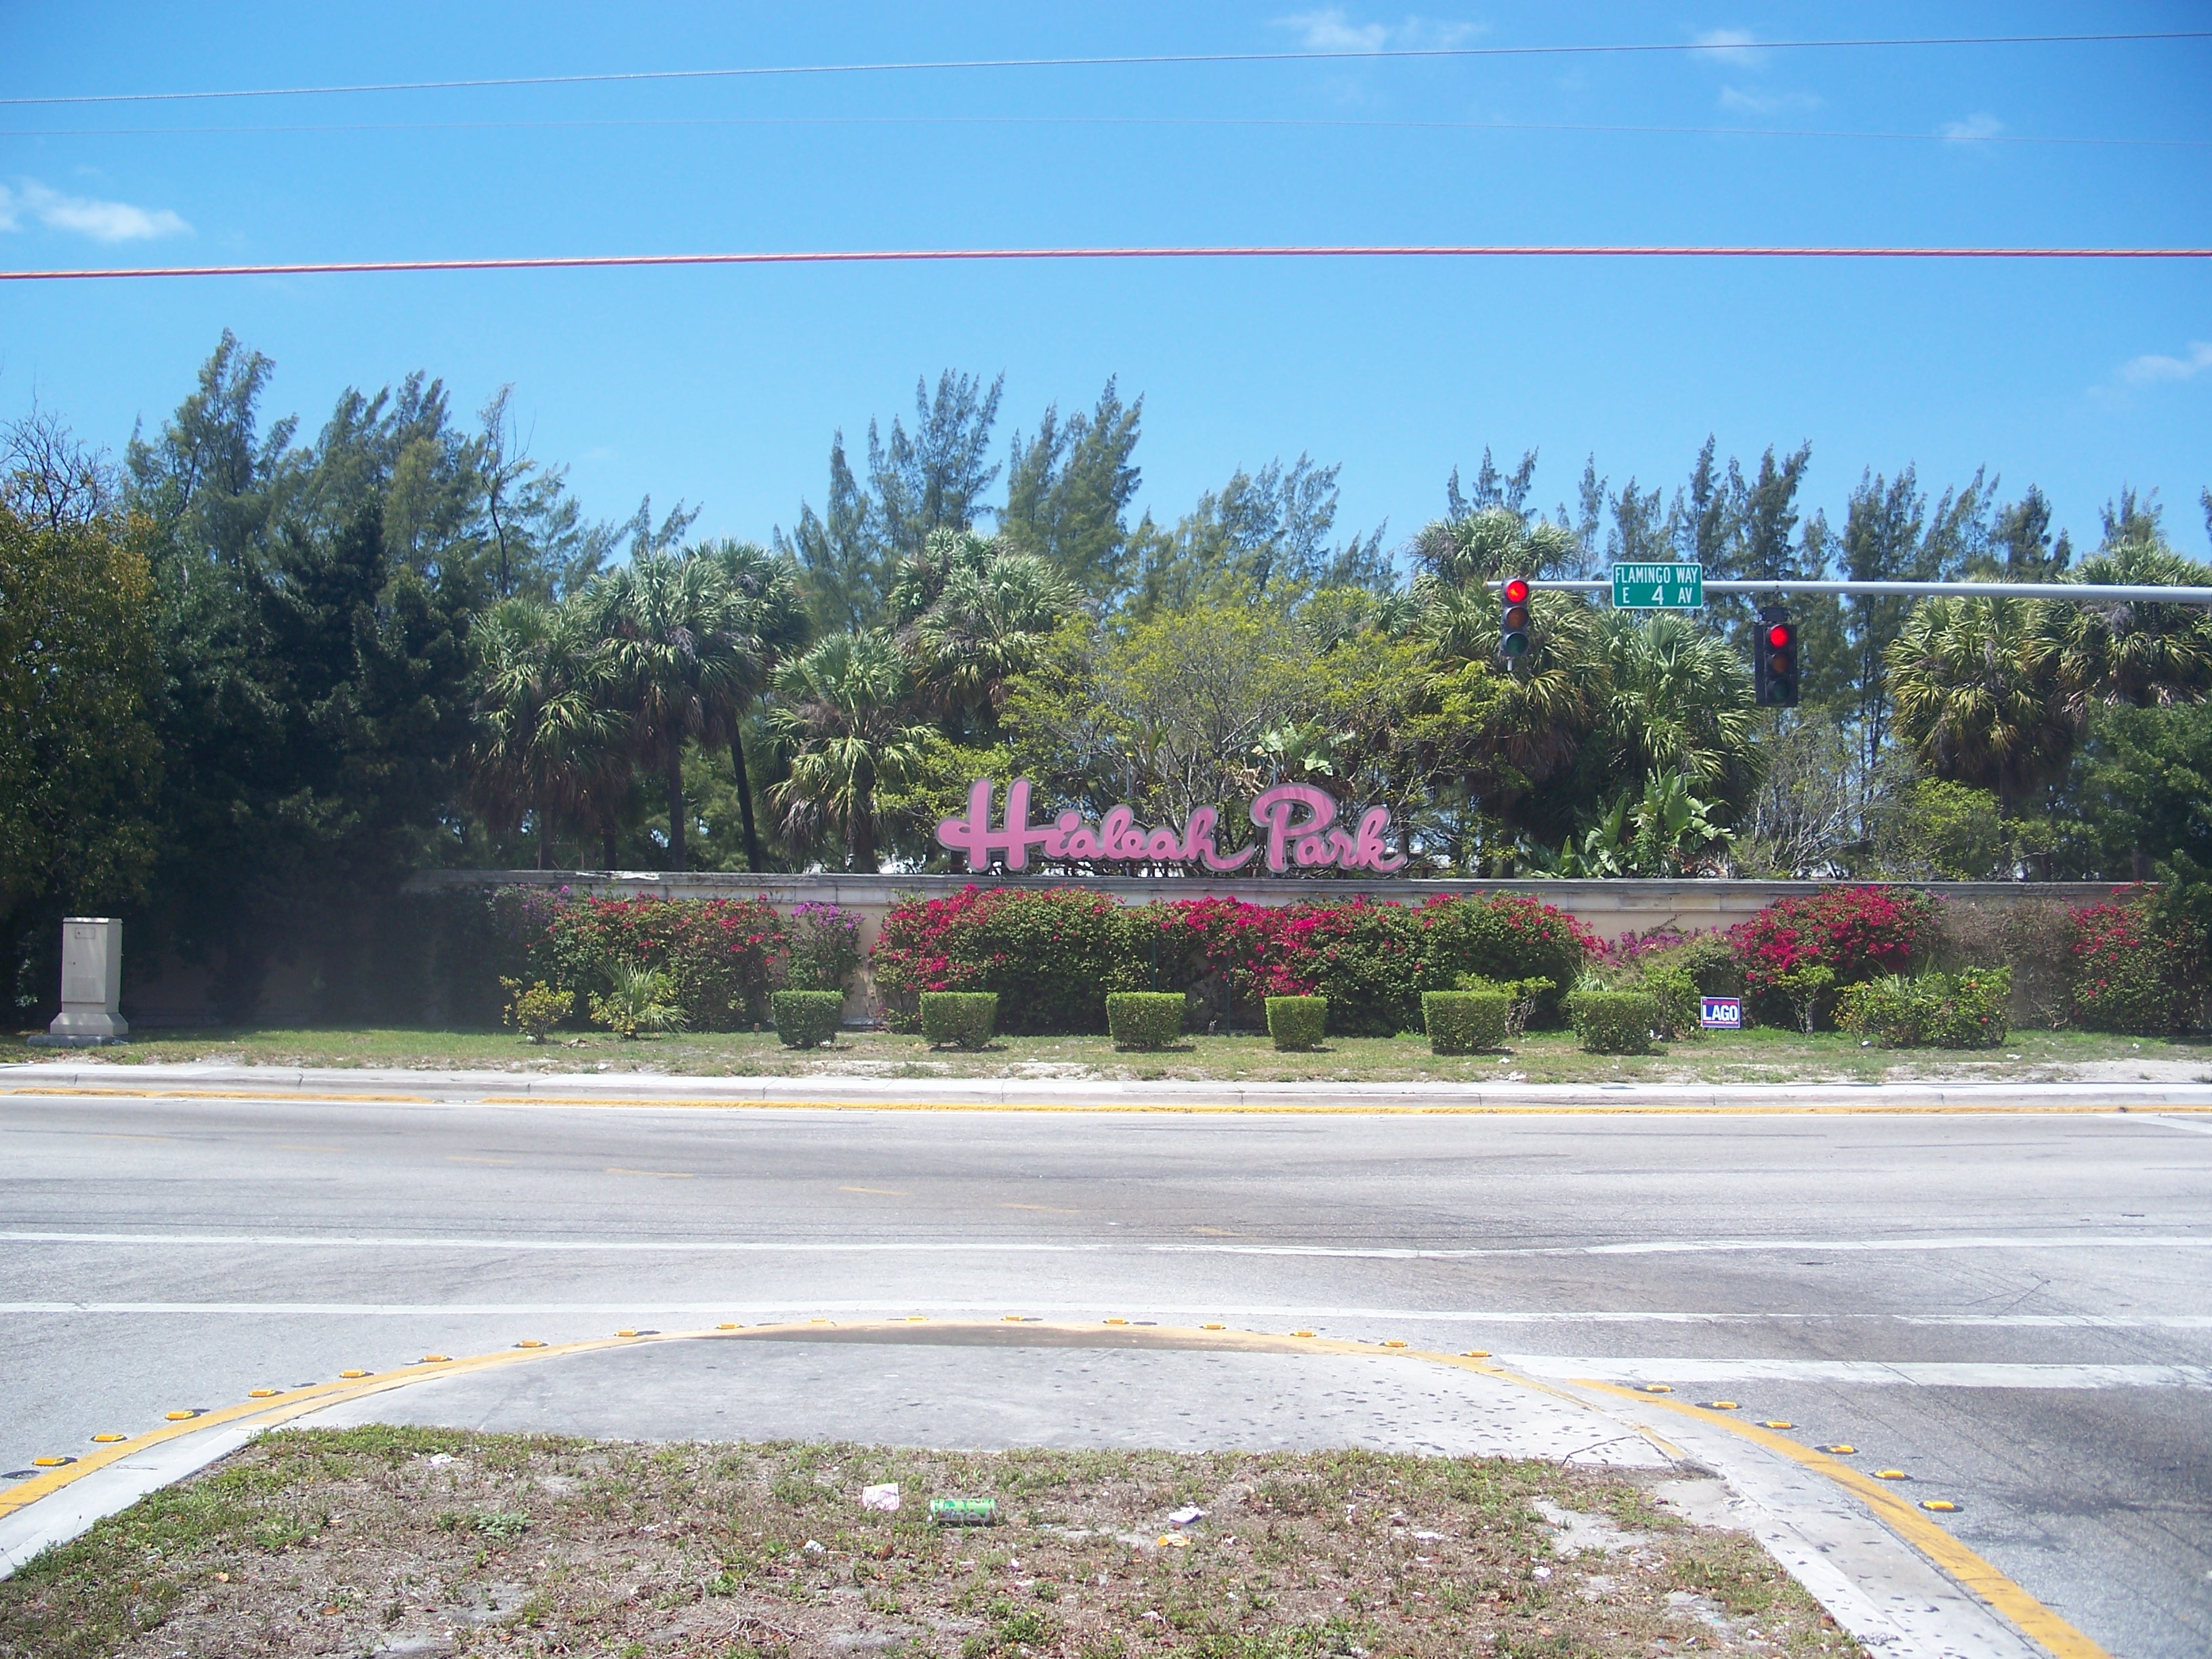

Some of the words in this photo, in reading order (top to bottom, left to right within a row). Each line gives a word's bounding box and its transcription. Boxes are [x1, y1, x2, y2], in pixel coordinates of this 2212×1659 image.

[1615, 567, 1671, 583] FLAMINGO
[1675, 567, 1698, 583] WAY
[1622, 587, 1630, 603] E
[1651, 585, 1664, 605] 4
[1677, 587, 1692, 604] AV
[937, 779, 1254, 870] Hialeah
[1251, 785, 1406, 872] Park
[1702, 1004, 1738, 1021] LAGO
